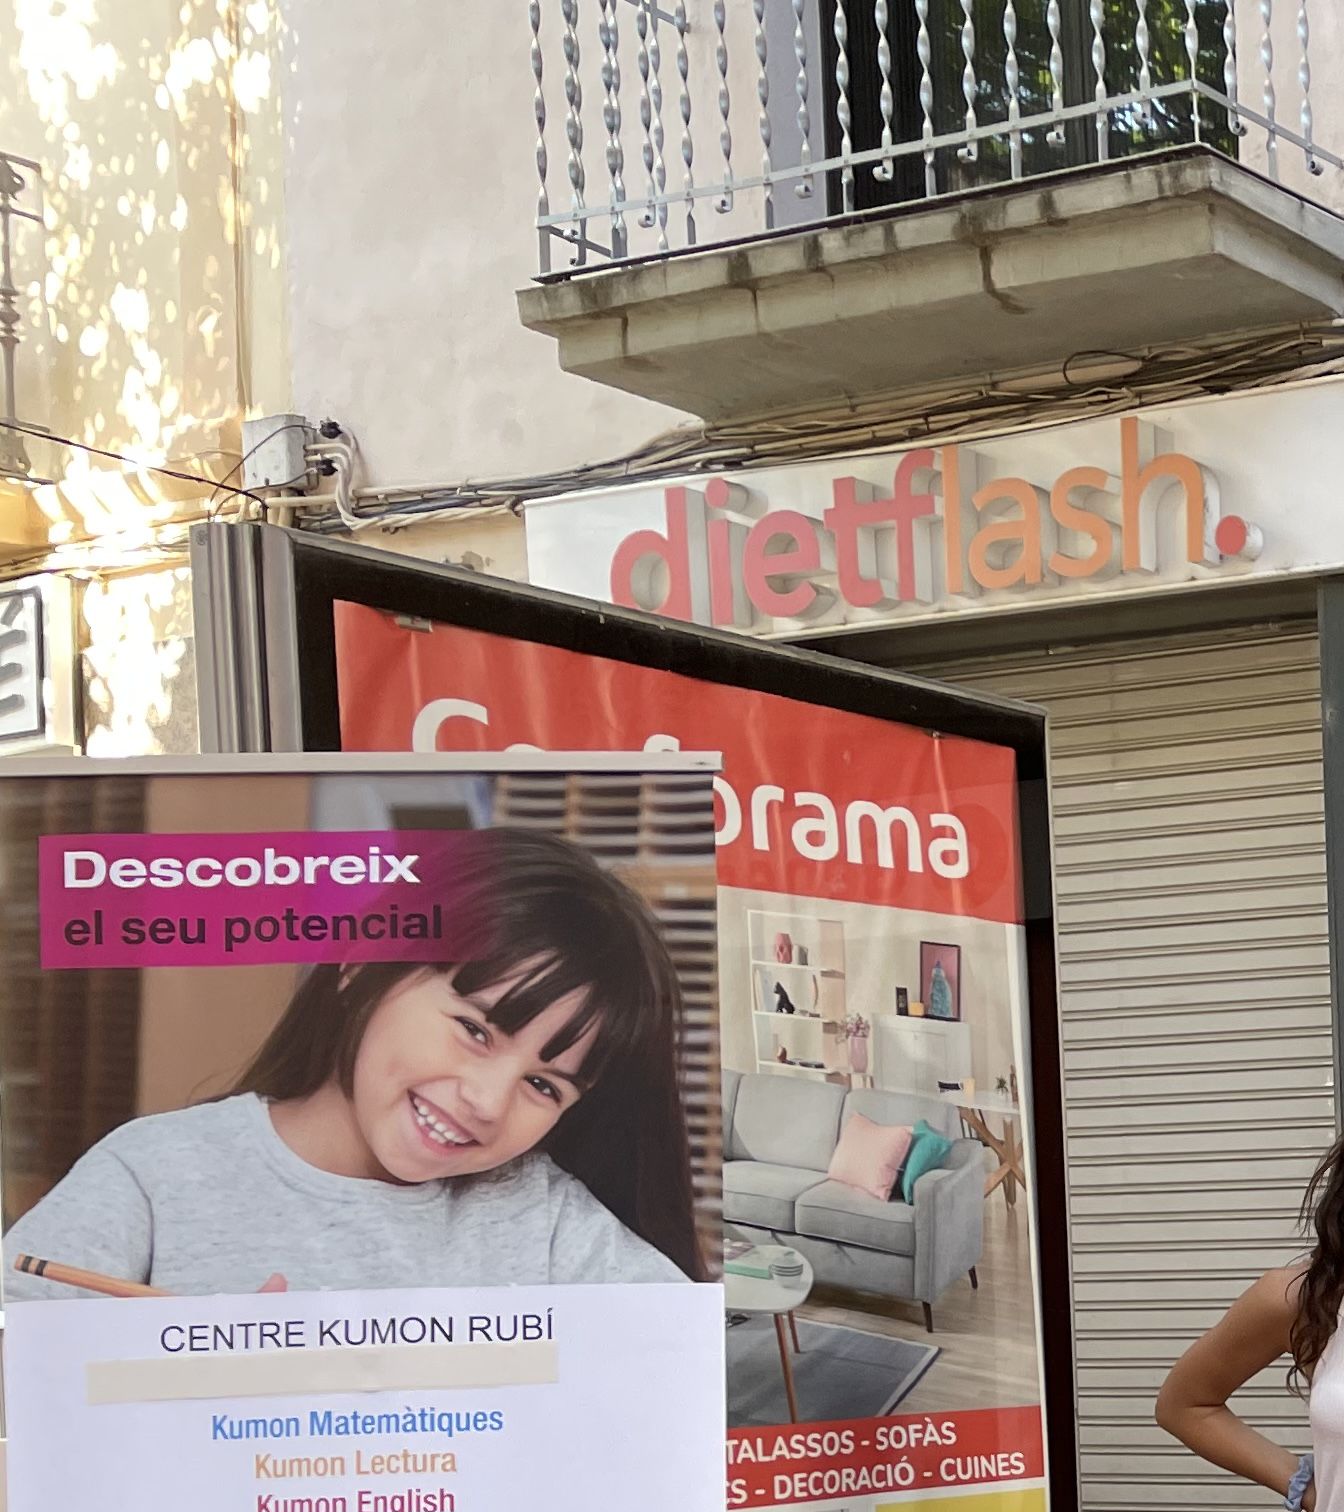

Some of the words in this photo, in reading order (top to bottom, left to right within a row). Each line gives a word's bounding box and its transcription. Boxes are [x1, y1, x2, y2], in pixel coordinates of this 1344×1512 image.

[63, 846, 421, 890] Descobreix
[65, 909, 102, 946] el
[121, 914, 207, 945] seu
[223, 904, 443, 953] potencial
[160, 1320, 305, 1353] CENTRE
[319, 1317, 453, 1346] KUMON
[468, 1308, 554, 1342] RUBÍ
[212, 1414, 300, 1440] Kumon
[309, 1406, 504, 1438] Matemàtiques
[876, 1417, 957, 1450] SOFÀS
[254, 1453, 345, 1479] Kumon
[355, 1449, 457, 1476] Lectura
[774, 1456, 914, 1499] DECORACIÓ
[940, 1452, 1025, 1481] CUINES
